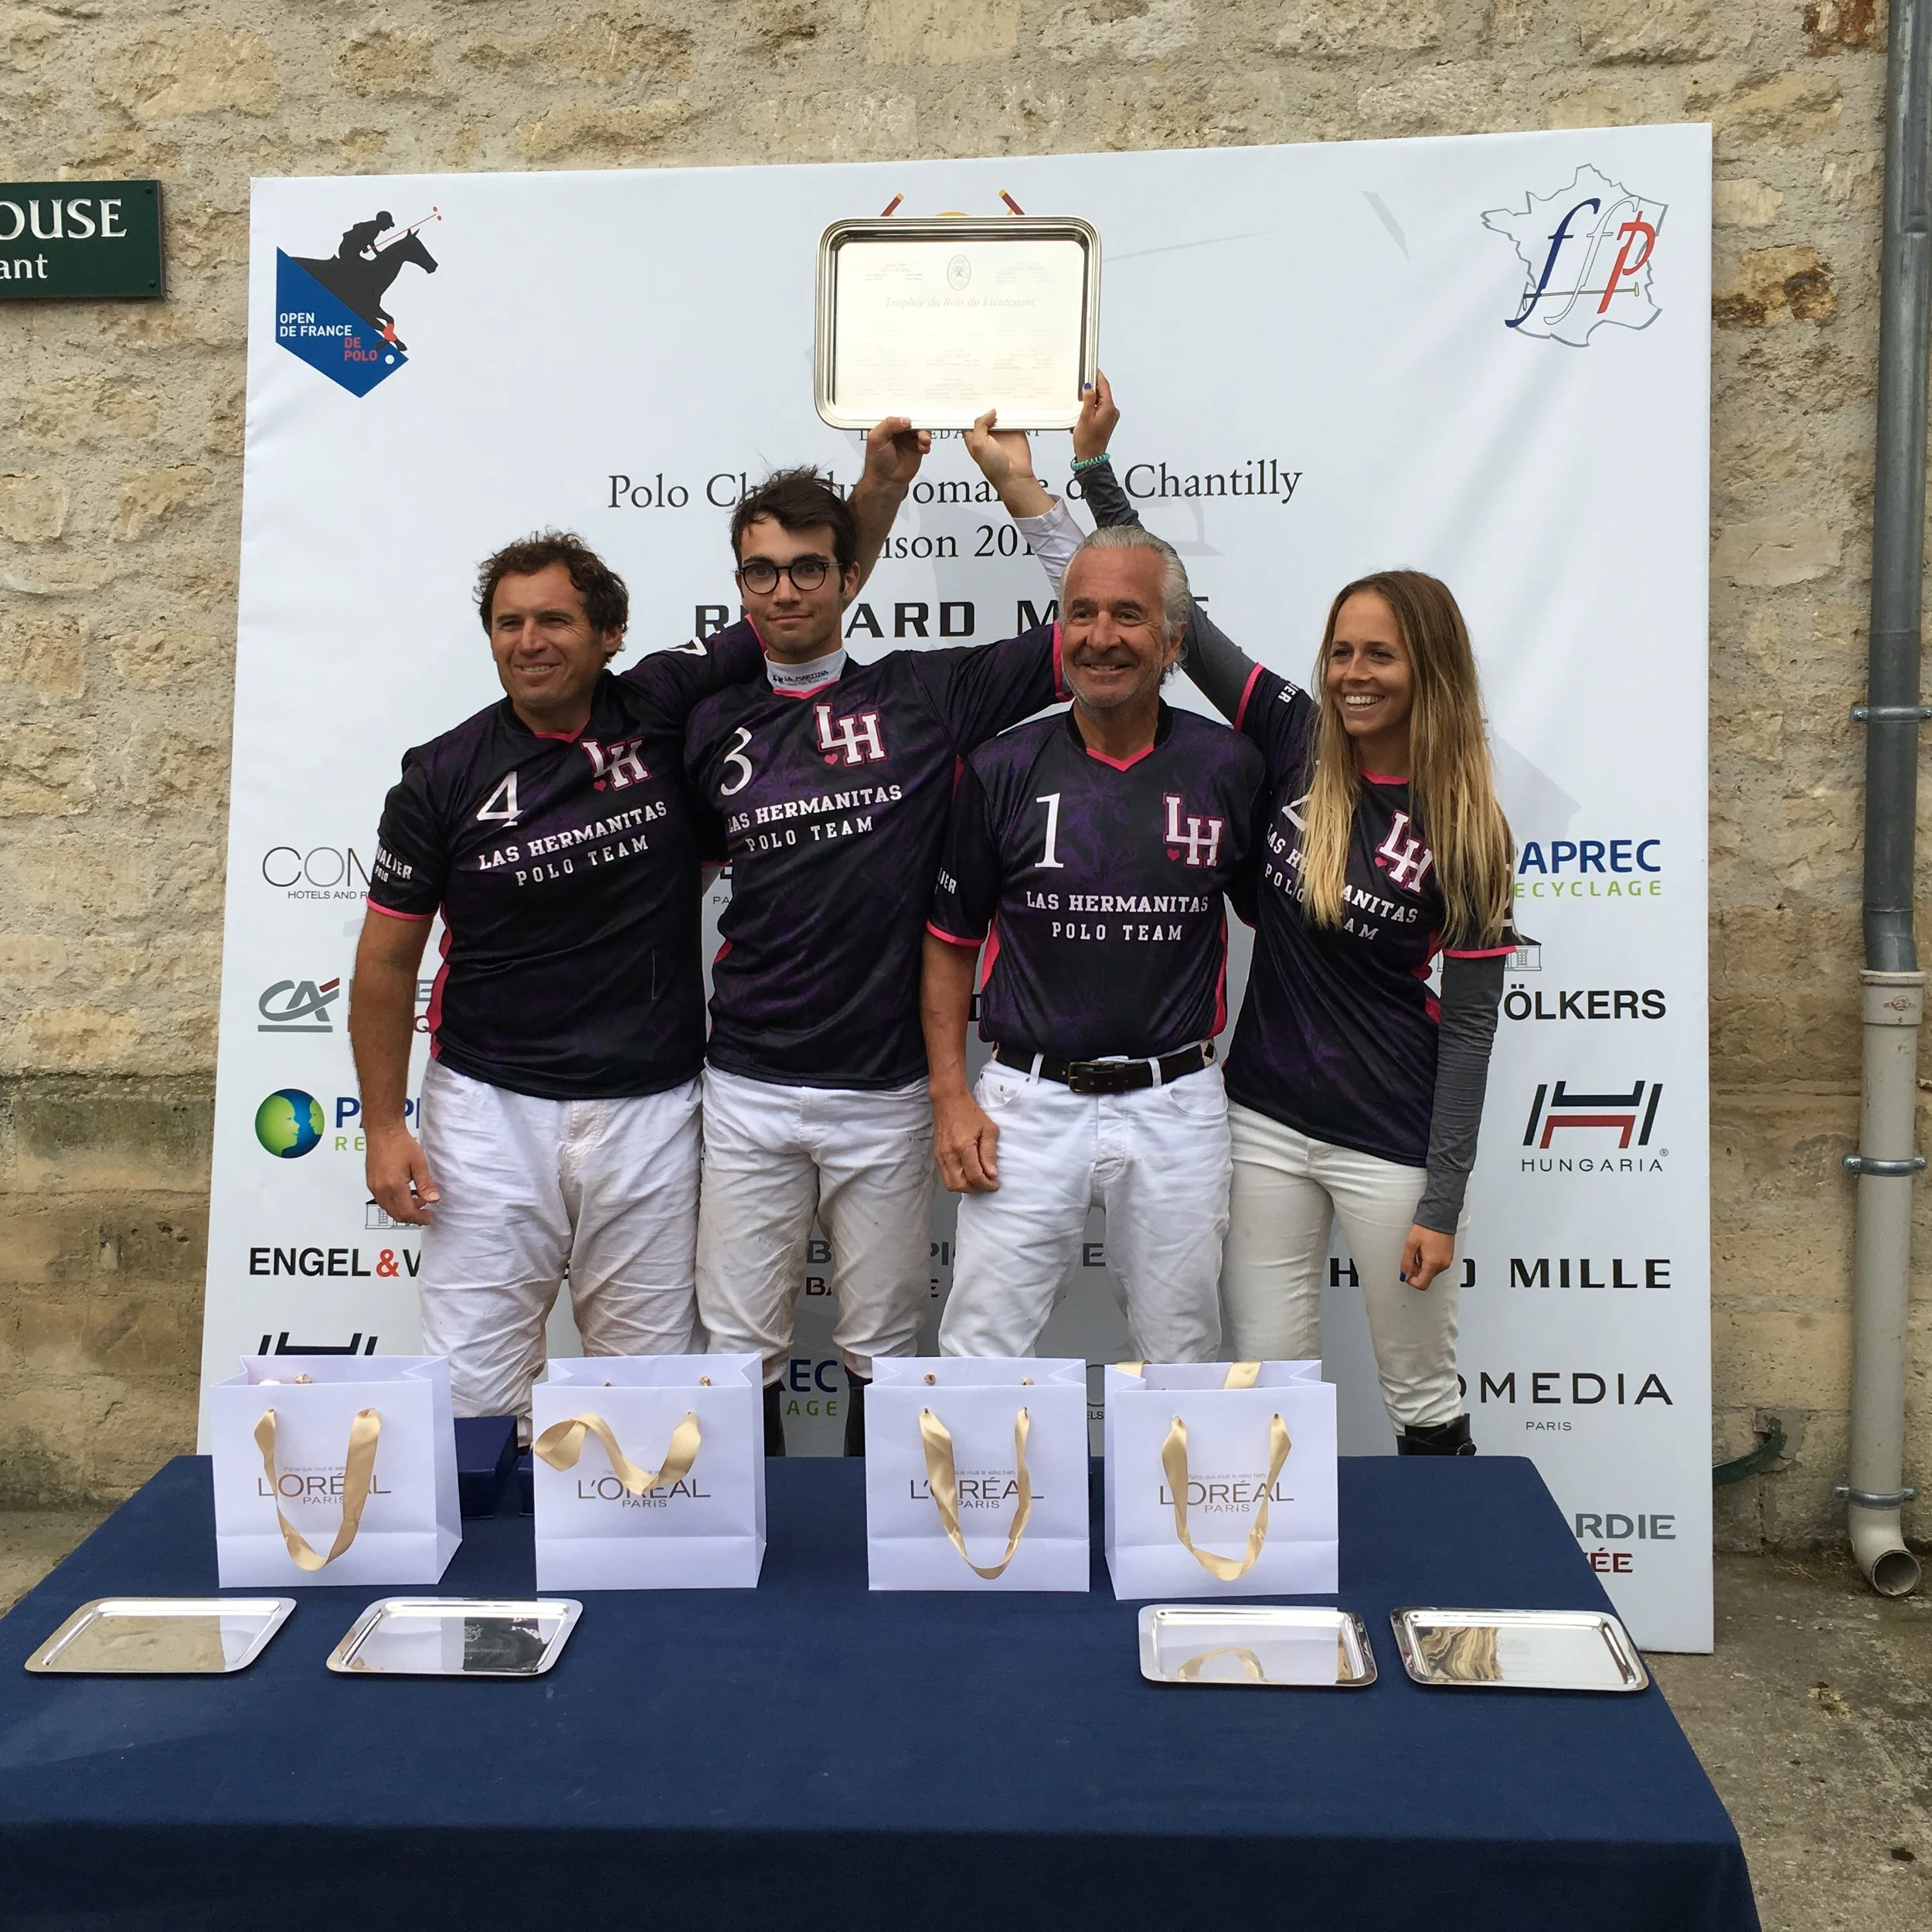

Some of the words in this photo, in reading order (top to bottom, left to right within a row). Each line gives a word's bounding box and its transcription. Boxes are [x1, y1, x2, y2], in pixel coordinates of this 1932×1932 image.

[280, 312, 315, 324] OPEN
[943, 297, 965, 308] Bois
[280, 325, 297, 337] DE
[300, 325, 352, 337] FRANCE
[344, 337, 361, 349] DE
[344, 349, 378, 361] POLO
[607, 472, 689, 508] Polo
[1124, 458, 1303, 504] Chantilly
[878, 533, 959, 560] ison
[695, 600, 976, 641] RARD
[814, 702, 887, 767] LH
[580, 736, 653, 792] LH
[720, 726, 753, 797] 3
[476, 771, 524, 828] 4
[754, 784, 903, 825] HERMANITAS
[478, 845, 521, 870] LAS
[527, 801, 667, 858] HERMANITAS
[746, 829, 798, 852] POLO
[810, 815, 873, 841] TEAM
[1034, 792, 1064, 869] 1
[1162, 791, 1225, 869] LH
[515, 859, 575, 886] POLO
[587, 835, 649, 867] TEAM
[1375, 808, 1434, 896] LH
[1516, 839, 1662, 875] APREC
[287, 890, 331, 900] HOTELS
[333, 890, 358, 900] AND
[1026, 890, 1060, 911] LAS
[1068, 893, 1209, 913] HERMANITAS
[1051, 921, 1106, 941] POLO
[1122, 924, 1182, 941] TEAM
[1503, 983, 1666, 1021] ÖLKERS
[1509, 1258, 1672, 1289] MILLE
[1526, 1421, 1573, 1431] PARIS
[1575, 1513, 1677, 1540] RDIE
